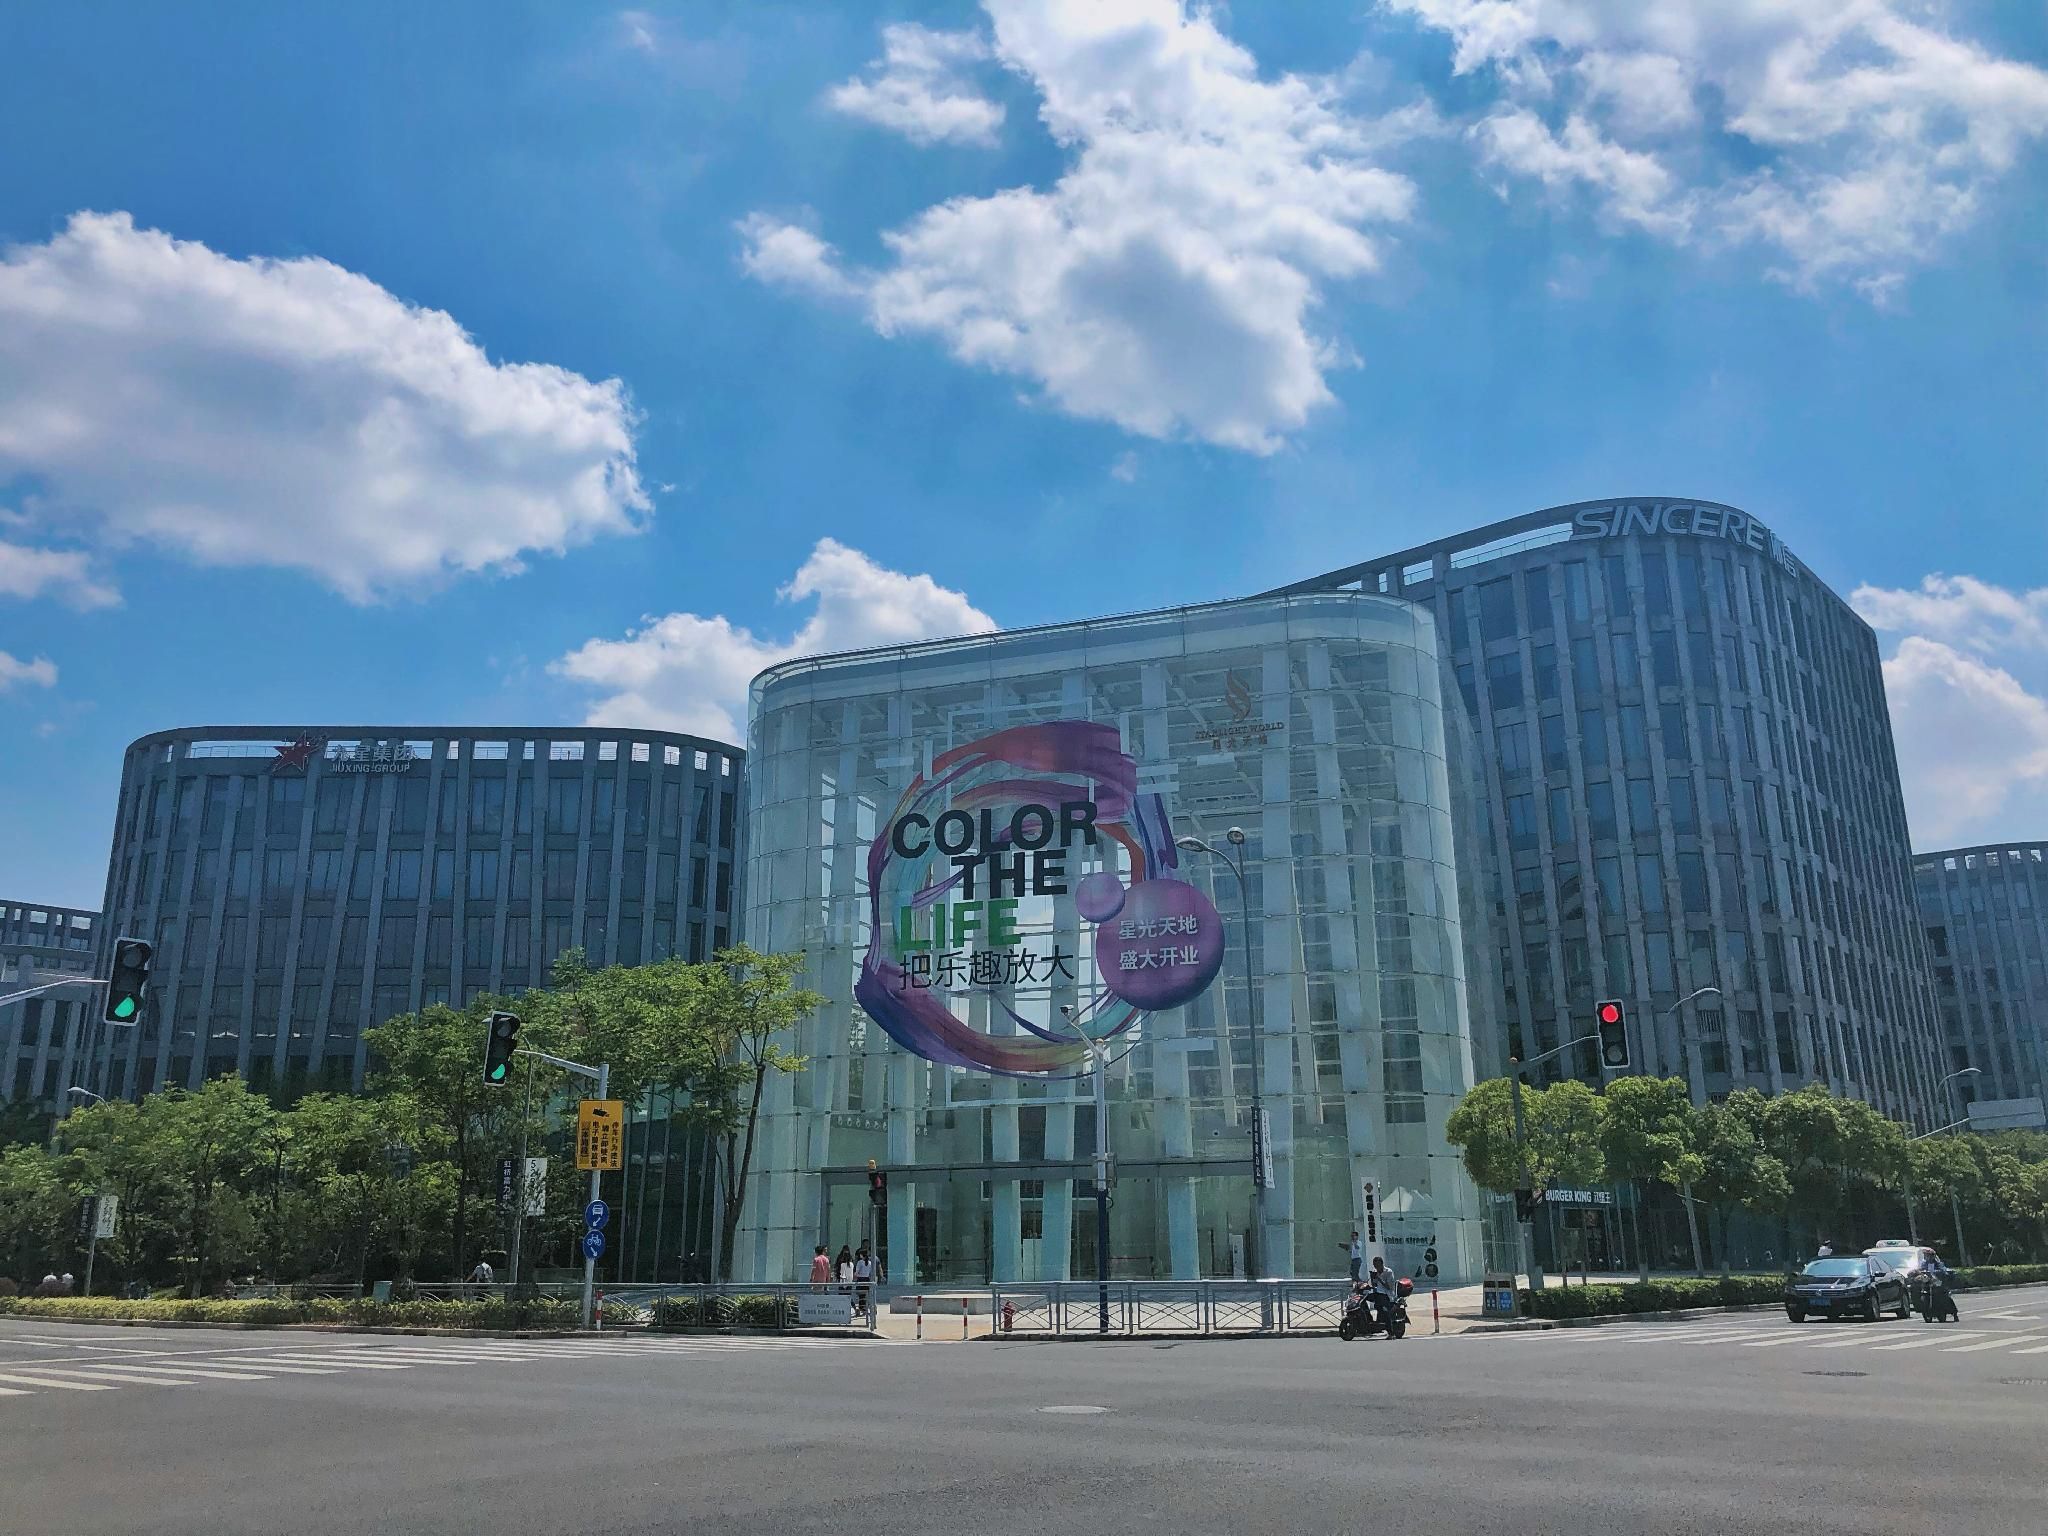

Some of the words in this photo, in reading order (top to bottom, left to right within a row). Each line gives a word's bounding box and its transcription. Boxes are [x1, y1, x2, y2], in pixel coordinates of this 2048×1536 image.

[1569, 503, 1764, 550] SINCERE
[1248, 722, 1284, 733] WORLD
[331, 744, 413, 762] 九星集团
[330, 763, 370, 773] JIUXING
[375, 763, 410, 773] GROUP
[892, 801, 1098, 859] COLOR
[951, 850, 1068, 900] THE
[900, 898, 1021, 950] LIFE
[1118, 914, 1198, 940] 星光天地
[899, 945, 1074, 990] 把乐趣放大
[1119, 945, 1199, 972] 盛大开业
[1545, 1190, 1574, 1201] BURGER
[1574, 1190, 1591, 1203] KING
